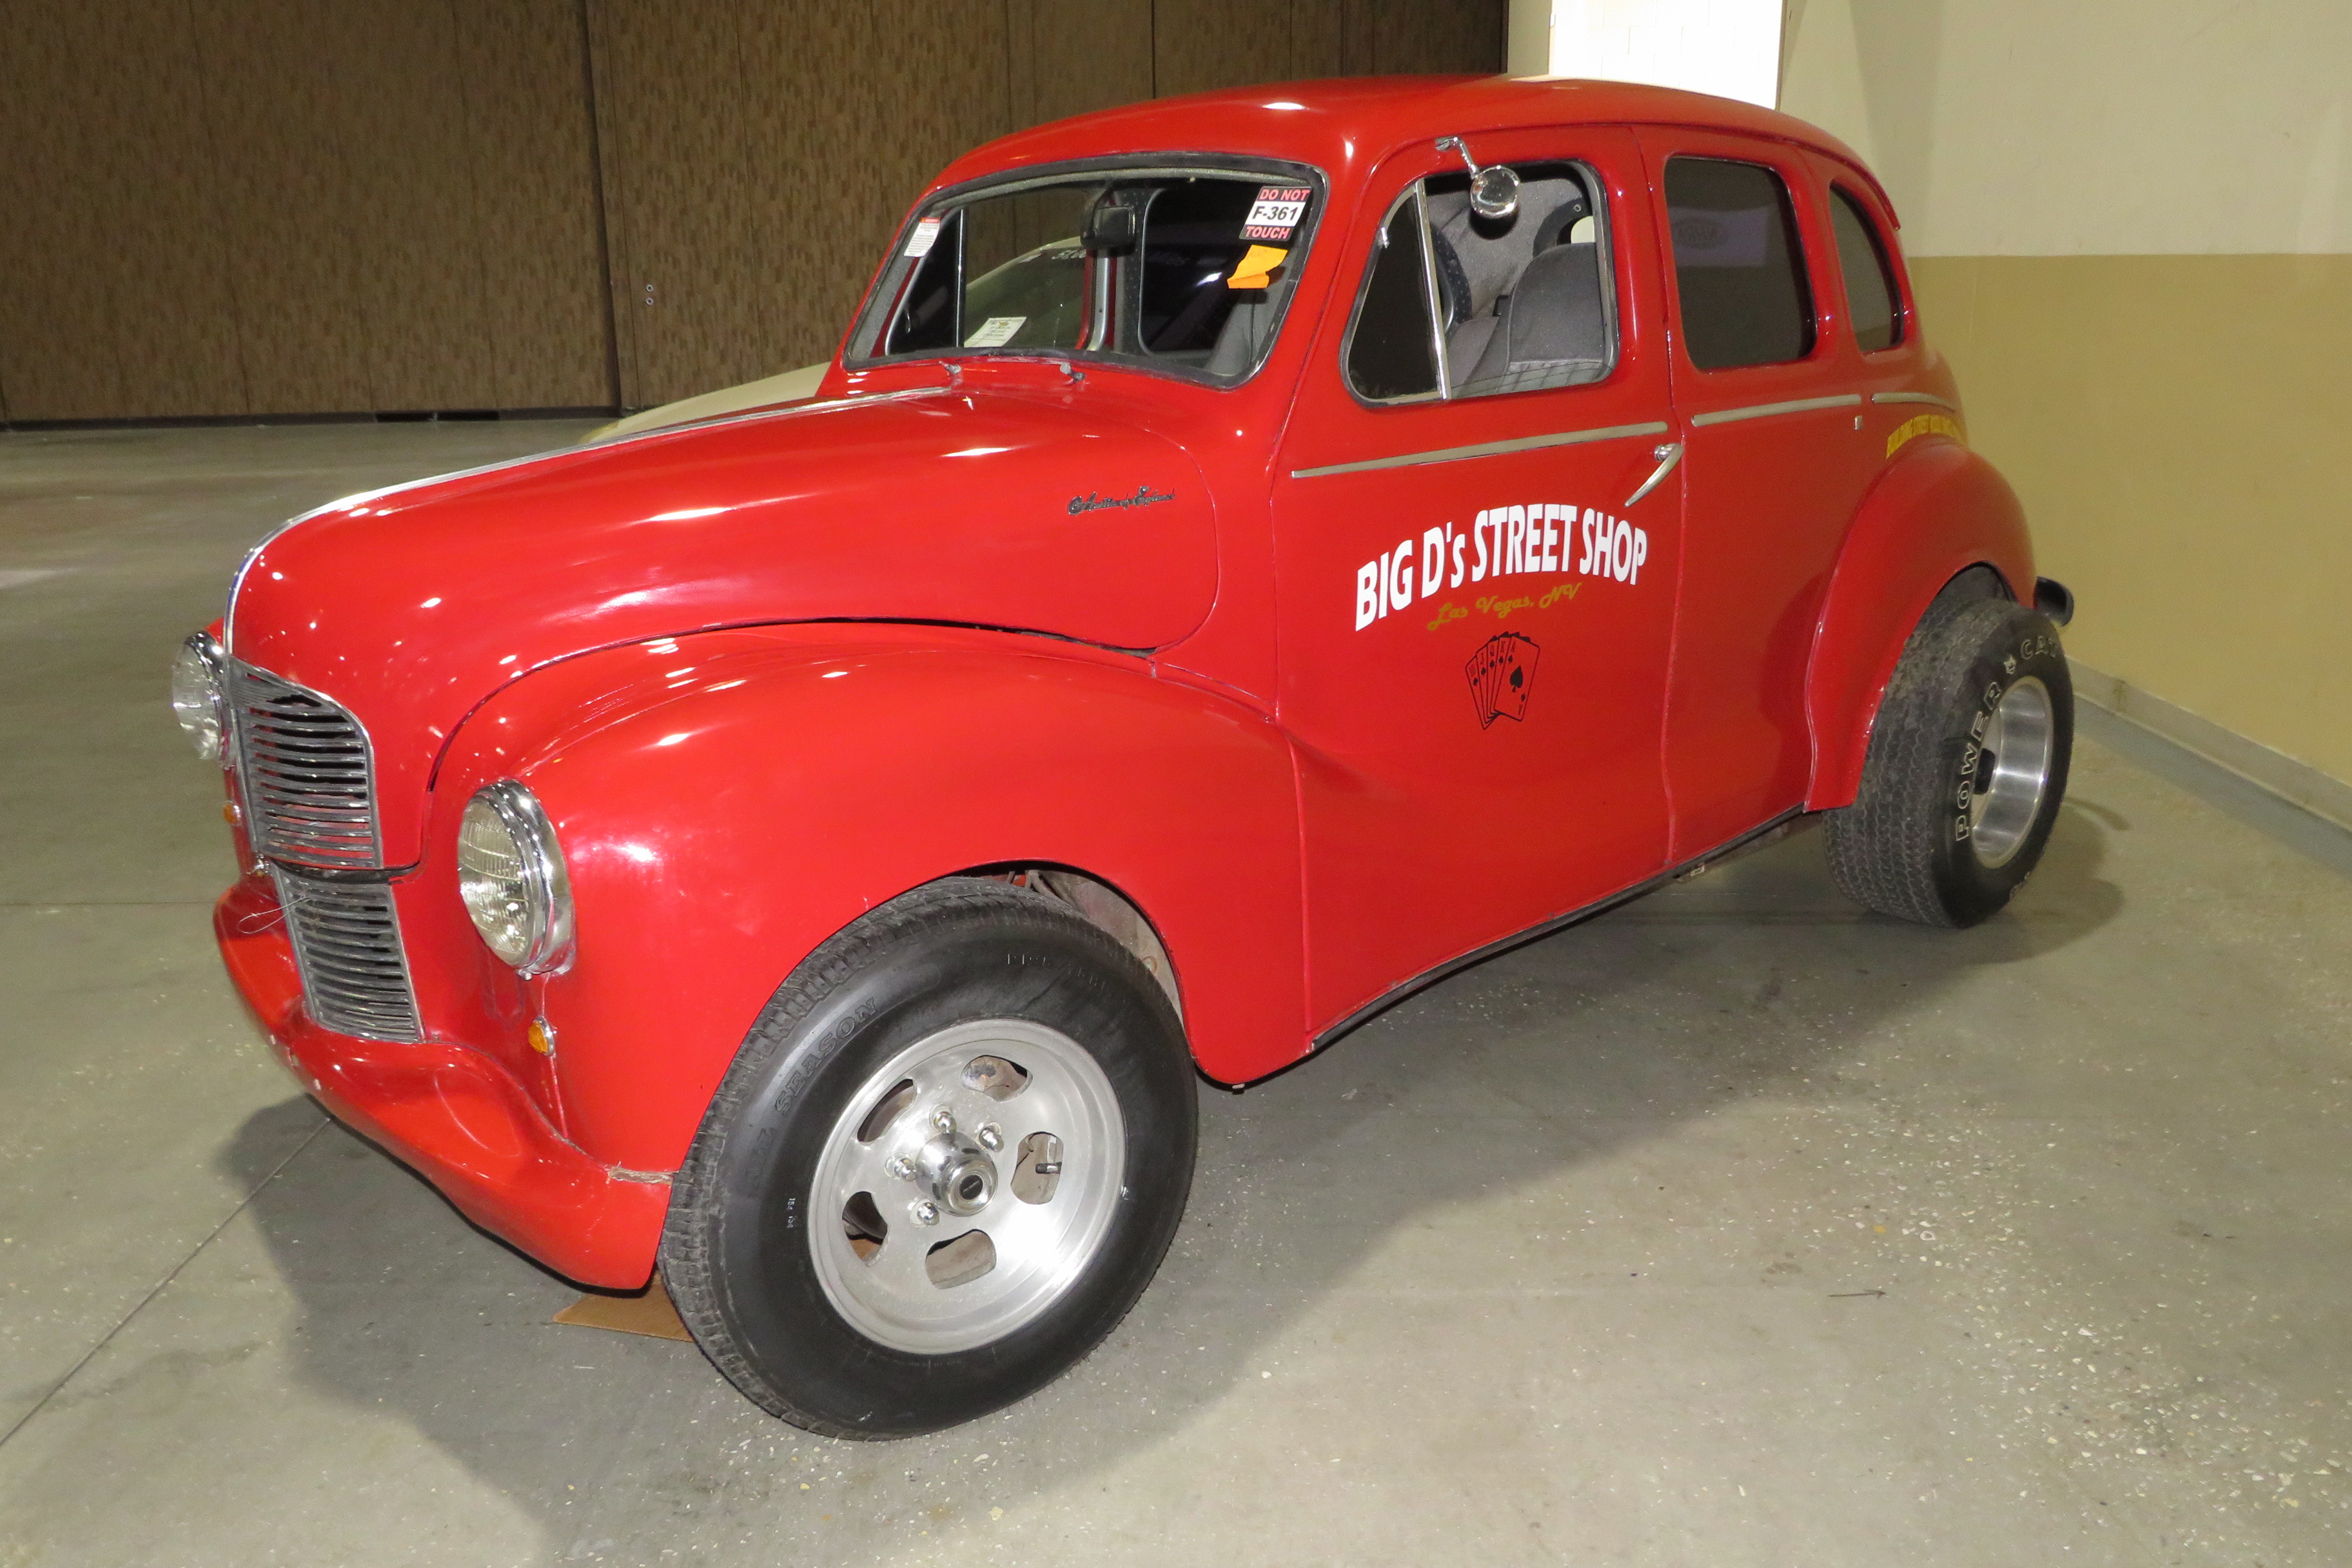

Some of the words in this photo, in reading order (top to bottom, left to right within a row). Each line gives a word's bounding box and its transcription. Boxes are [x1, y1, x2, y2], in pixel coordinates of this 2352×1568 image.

[1252, 206, 1298, 221] F-361
[1259, 189, 1279, 201] DO
[1280, 189, 1311, 201] NOT
[1245, 226, 1291, 239] TOUCH
[1355, 539, 1413, 632] BIG
[1421, 521, 1465, 599] D's
[1471, 503, 1578, 582] STREET
[1579, 507, 1648, 585] SHOP
[1427, 602, 1469, 631] Las
[1539, 582, 1583, 609] NV
[1955, 681, 2002, 842] POWER
[775, 997, 877, 1116] SEASON
